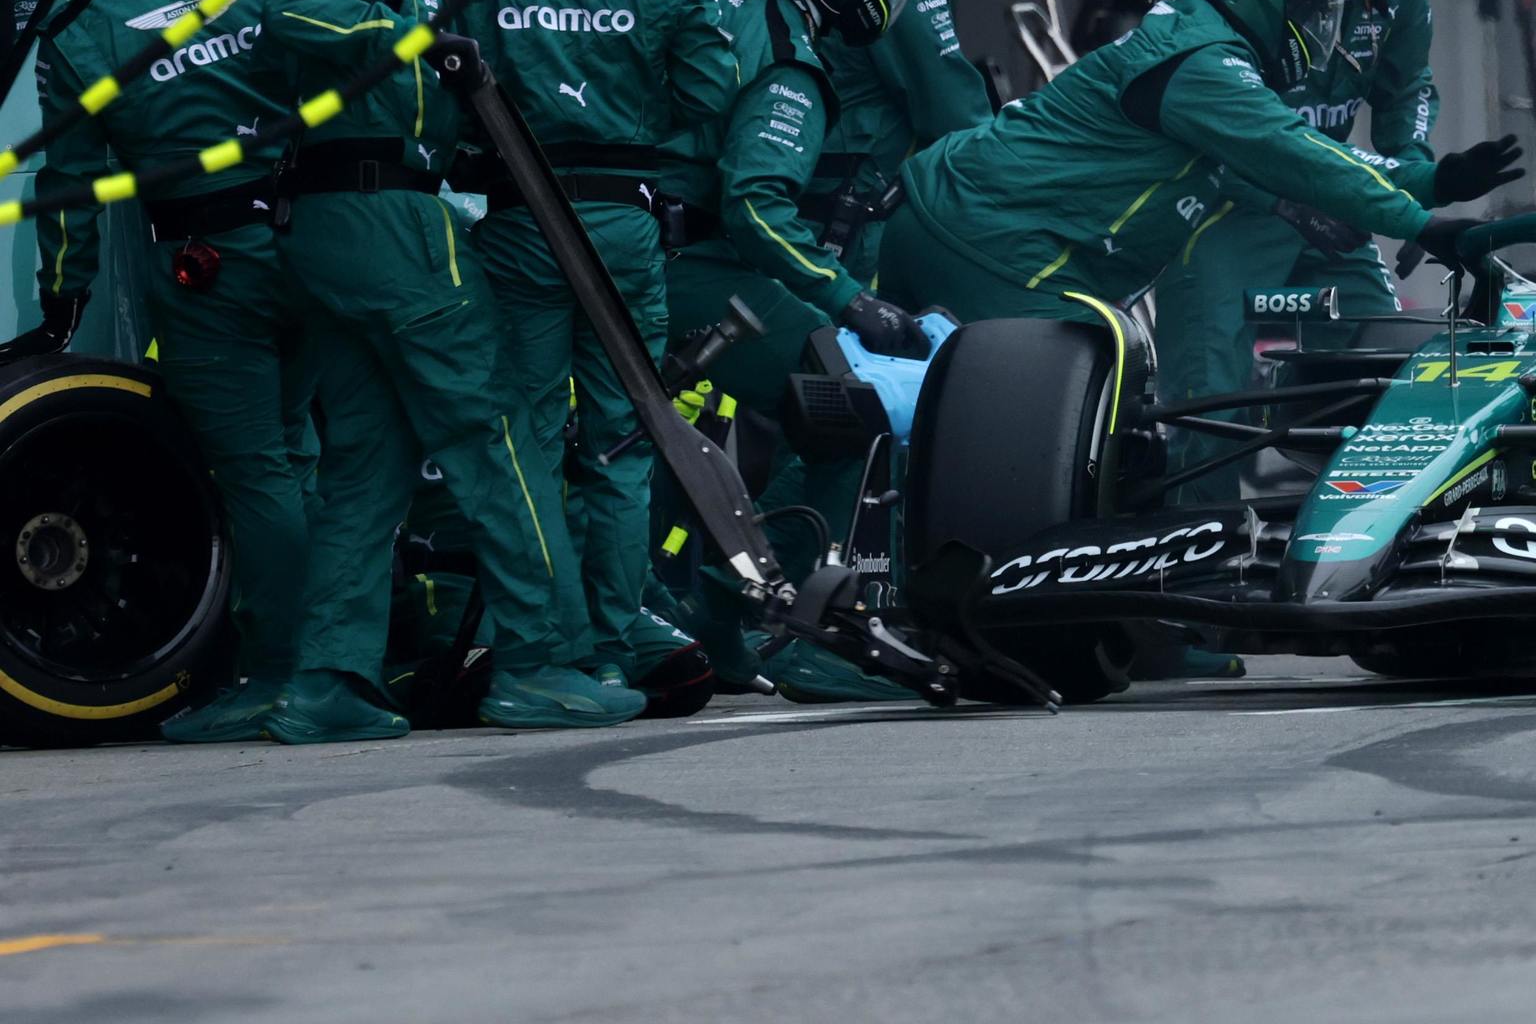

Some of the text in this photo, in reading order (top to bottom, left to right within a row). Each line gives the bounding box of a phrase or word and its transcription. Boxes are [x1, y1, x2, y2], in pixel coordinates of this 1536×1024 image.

[497, 6, 635, 33] aramco
[1254, 293, 1312, 313] BOSS
[1414, 360, 1522, 383] 14
[1362, 423, 1465, 433] NexGen
[1353, 433, 1456, 442] xerox
[1343, 444, 1448, 454] NetApp
[1319, 493, 1399, 501] Valvoline
[990, 521, 1225, 596] aramco
